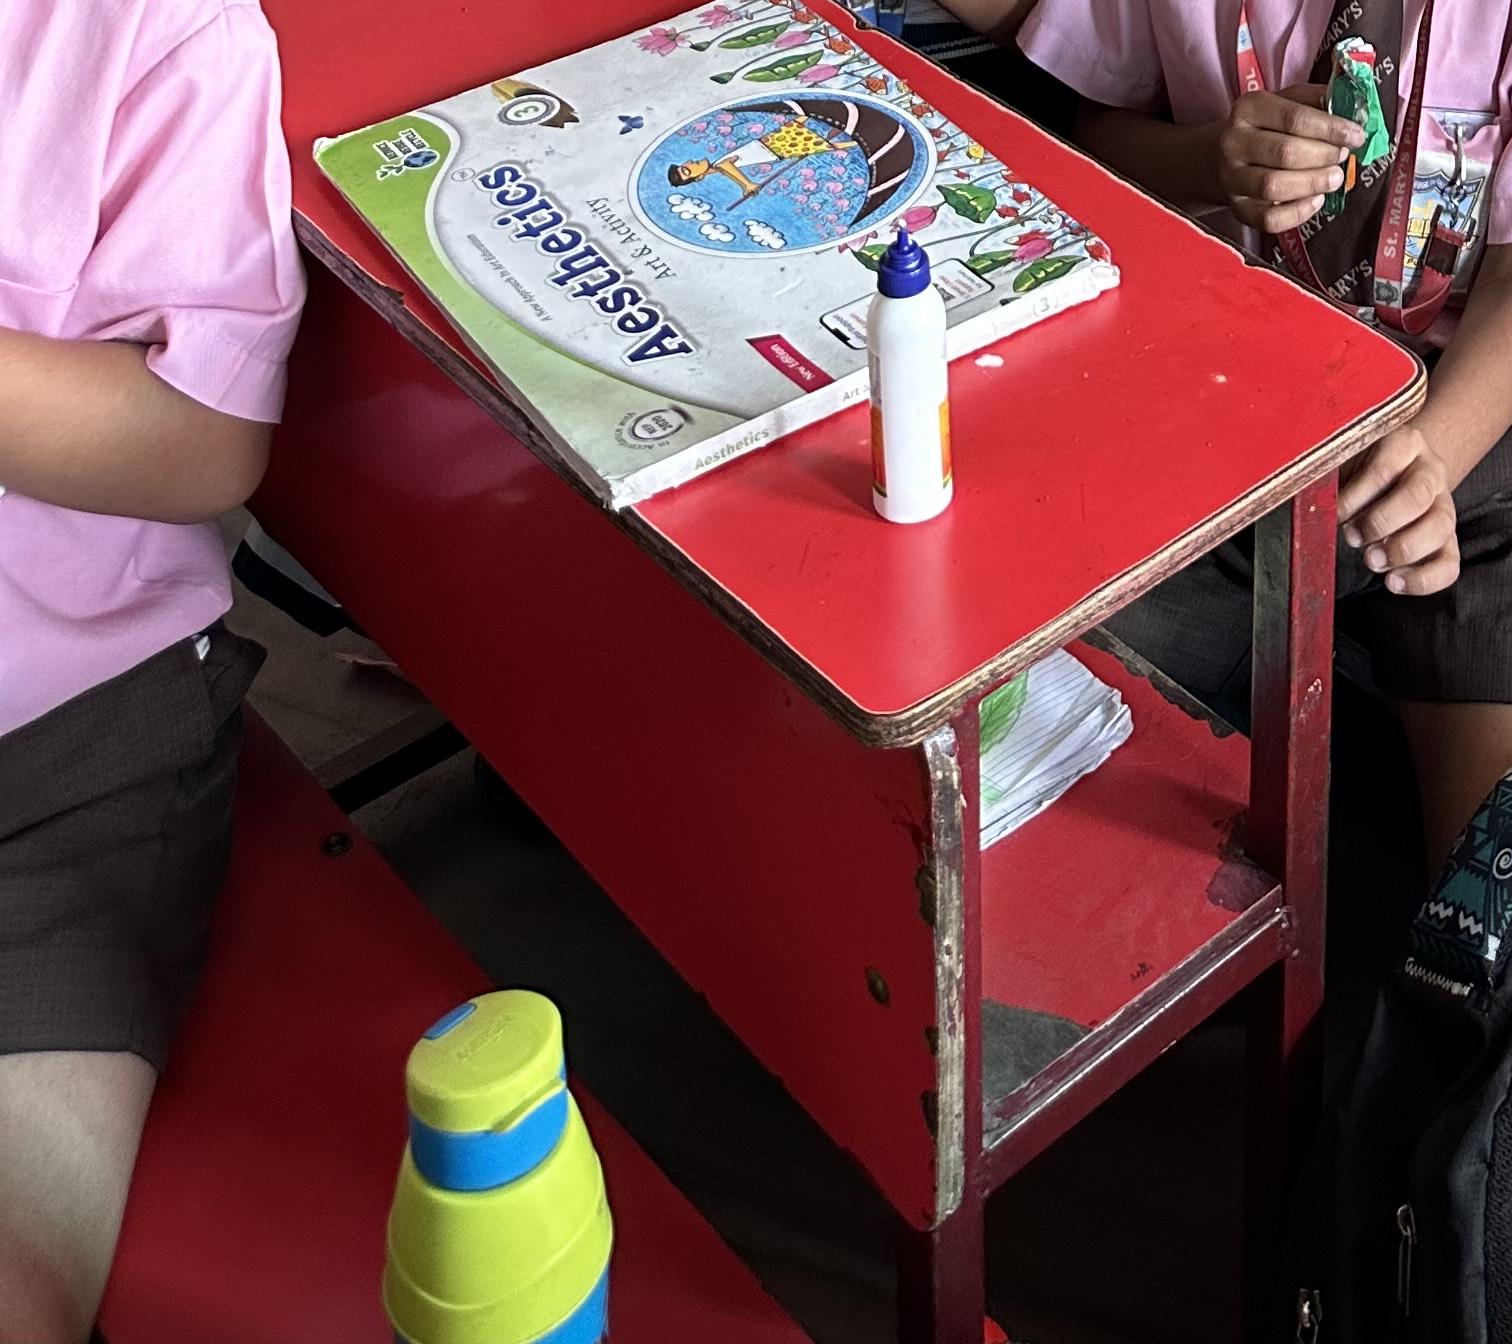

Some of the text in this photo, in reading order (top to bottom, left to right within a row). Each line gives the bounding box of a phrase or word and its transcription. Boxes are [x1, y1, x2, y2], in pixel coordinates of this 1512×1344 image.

[514, 105, 540, 118] 3
[1403, 74, 1421, 146] PUBLIC
[1390, 155, 1410, 226] MARY'S
[585, 197, 677, 280] Art & Activity
[1384, 231, 1398, 258] St.
[477, 165, 694, 363] Aesthetics
[770, 343, 799, 369] Edition
[842, 387, 861, 402] Art
[694, 428, 770, 471] Aesthetics
